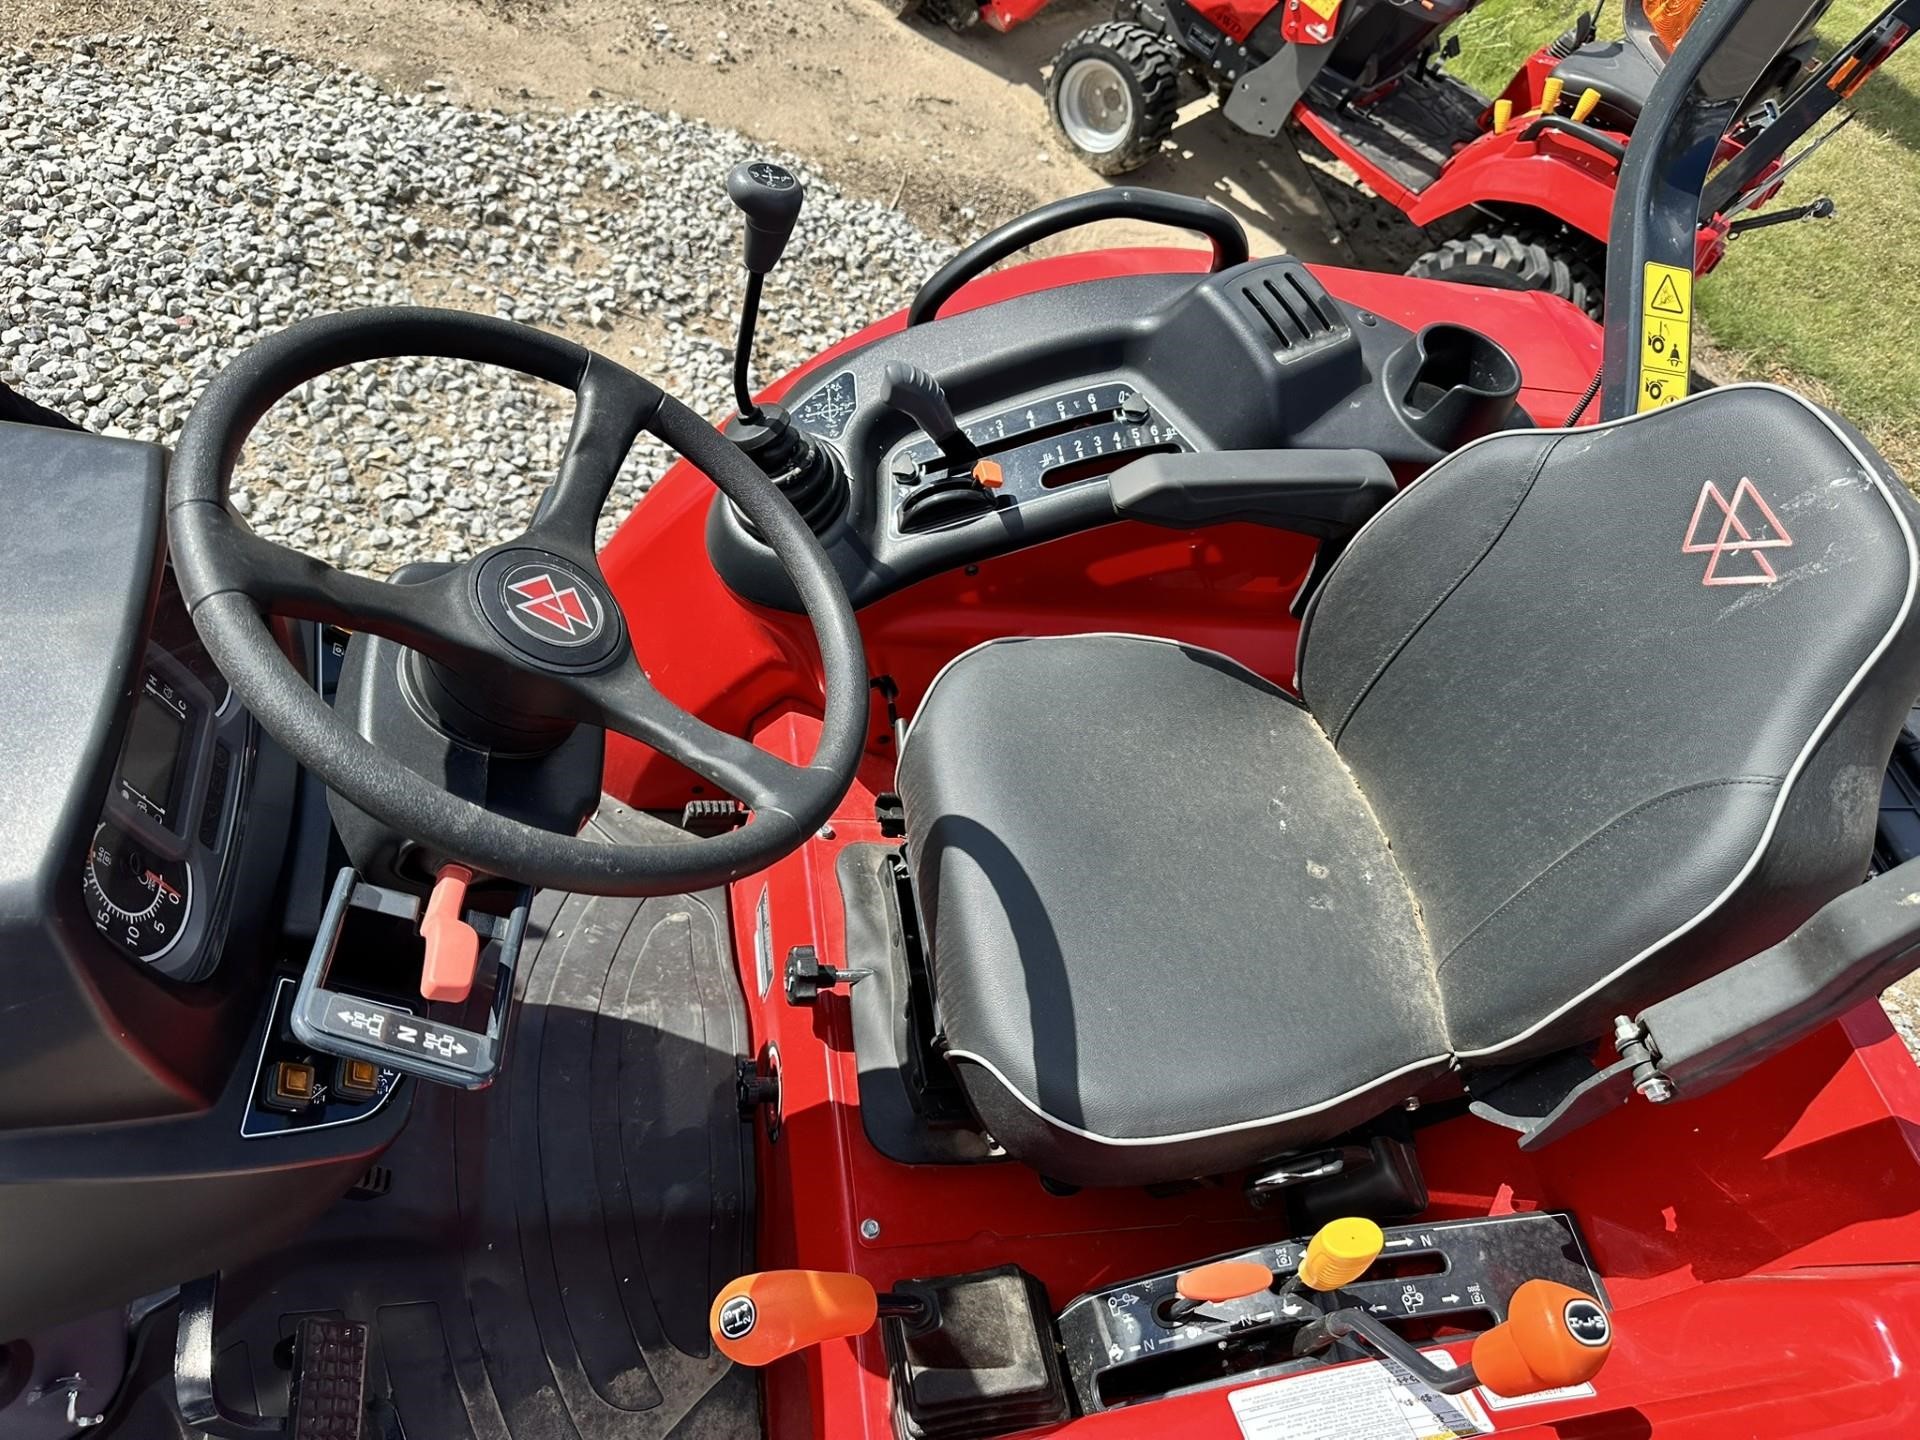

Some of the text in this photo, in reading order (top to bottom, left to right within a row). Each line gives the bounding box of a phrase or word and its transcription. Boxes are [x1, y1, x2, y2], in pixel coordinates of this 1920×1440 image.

[995, 419, 1004, 430] 3
[1026, 409, 1034, 420] 4
[1056, 401, 1065, 412] 5
[1087, 393, 1096, 404] 6
[1056, 425, 1159, 456] 1 2 3 4 5 6
[149, 674, 157, 686] H
[178, 700, 187, 711] C
[169, 892, 180, 905] 0
[95, 909, 110, 931] 15
[154, 920, 165, 934] 5
[126, 926, 140, 946] 10
[397, 1025, 418, 1043] N
[1420, 1234, 1432, 1248] N
[743, 1315, 751, 1324] 2
[1240, 1313, 1252, 1327] N
[1143, 1339, 1155, 1352] N
